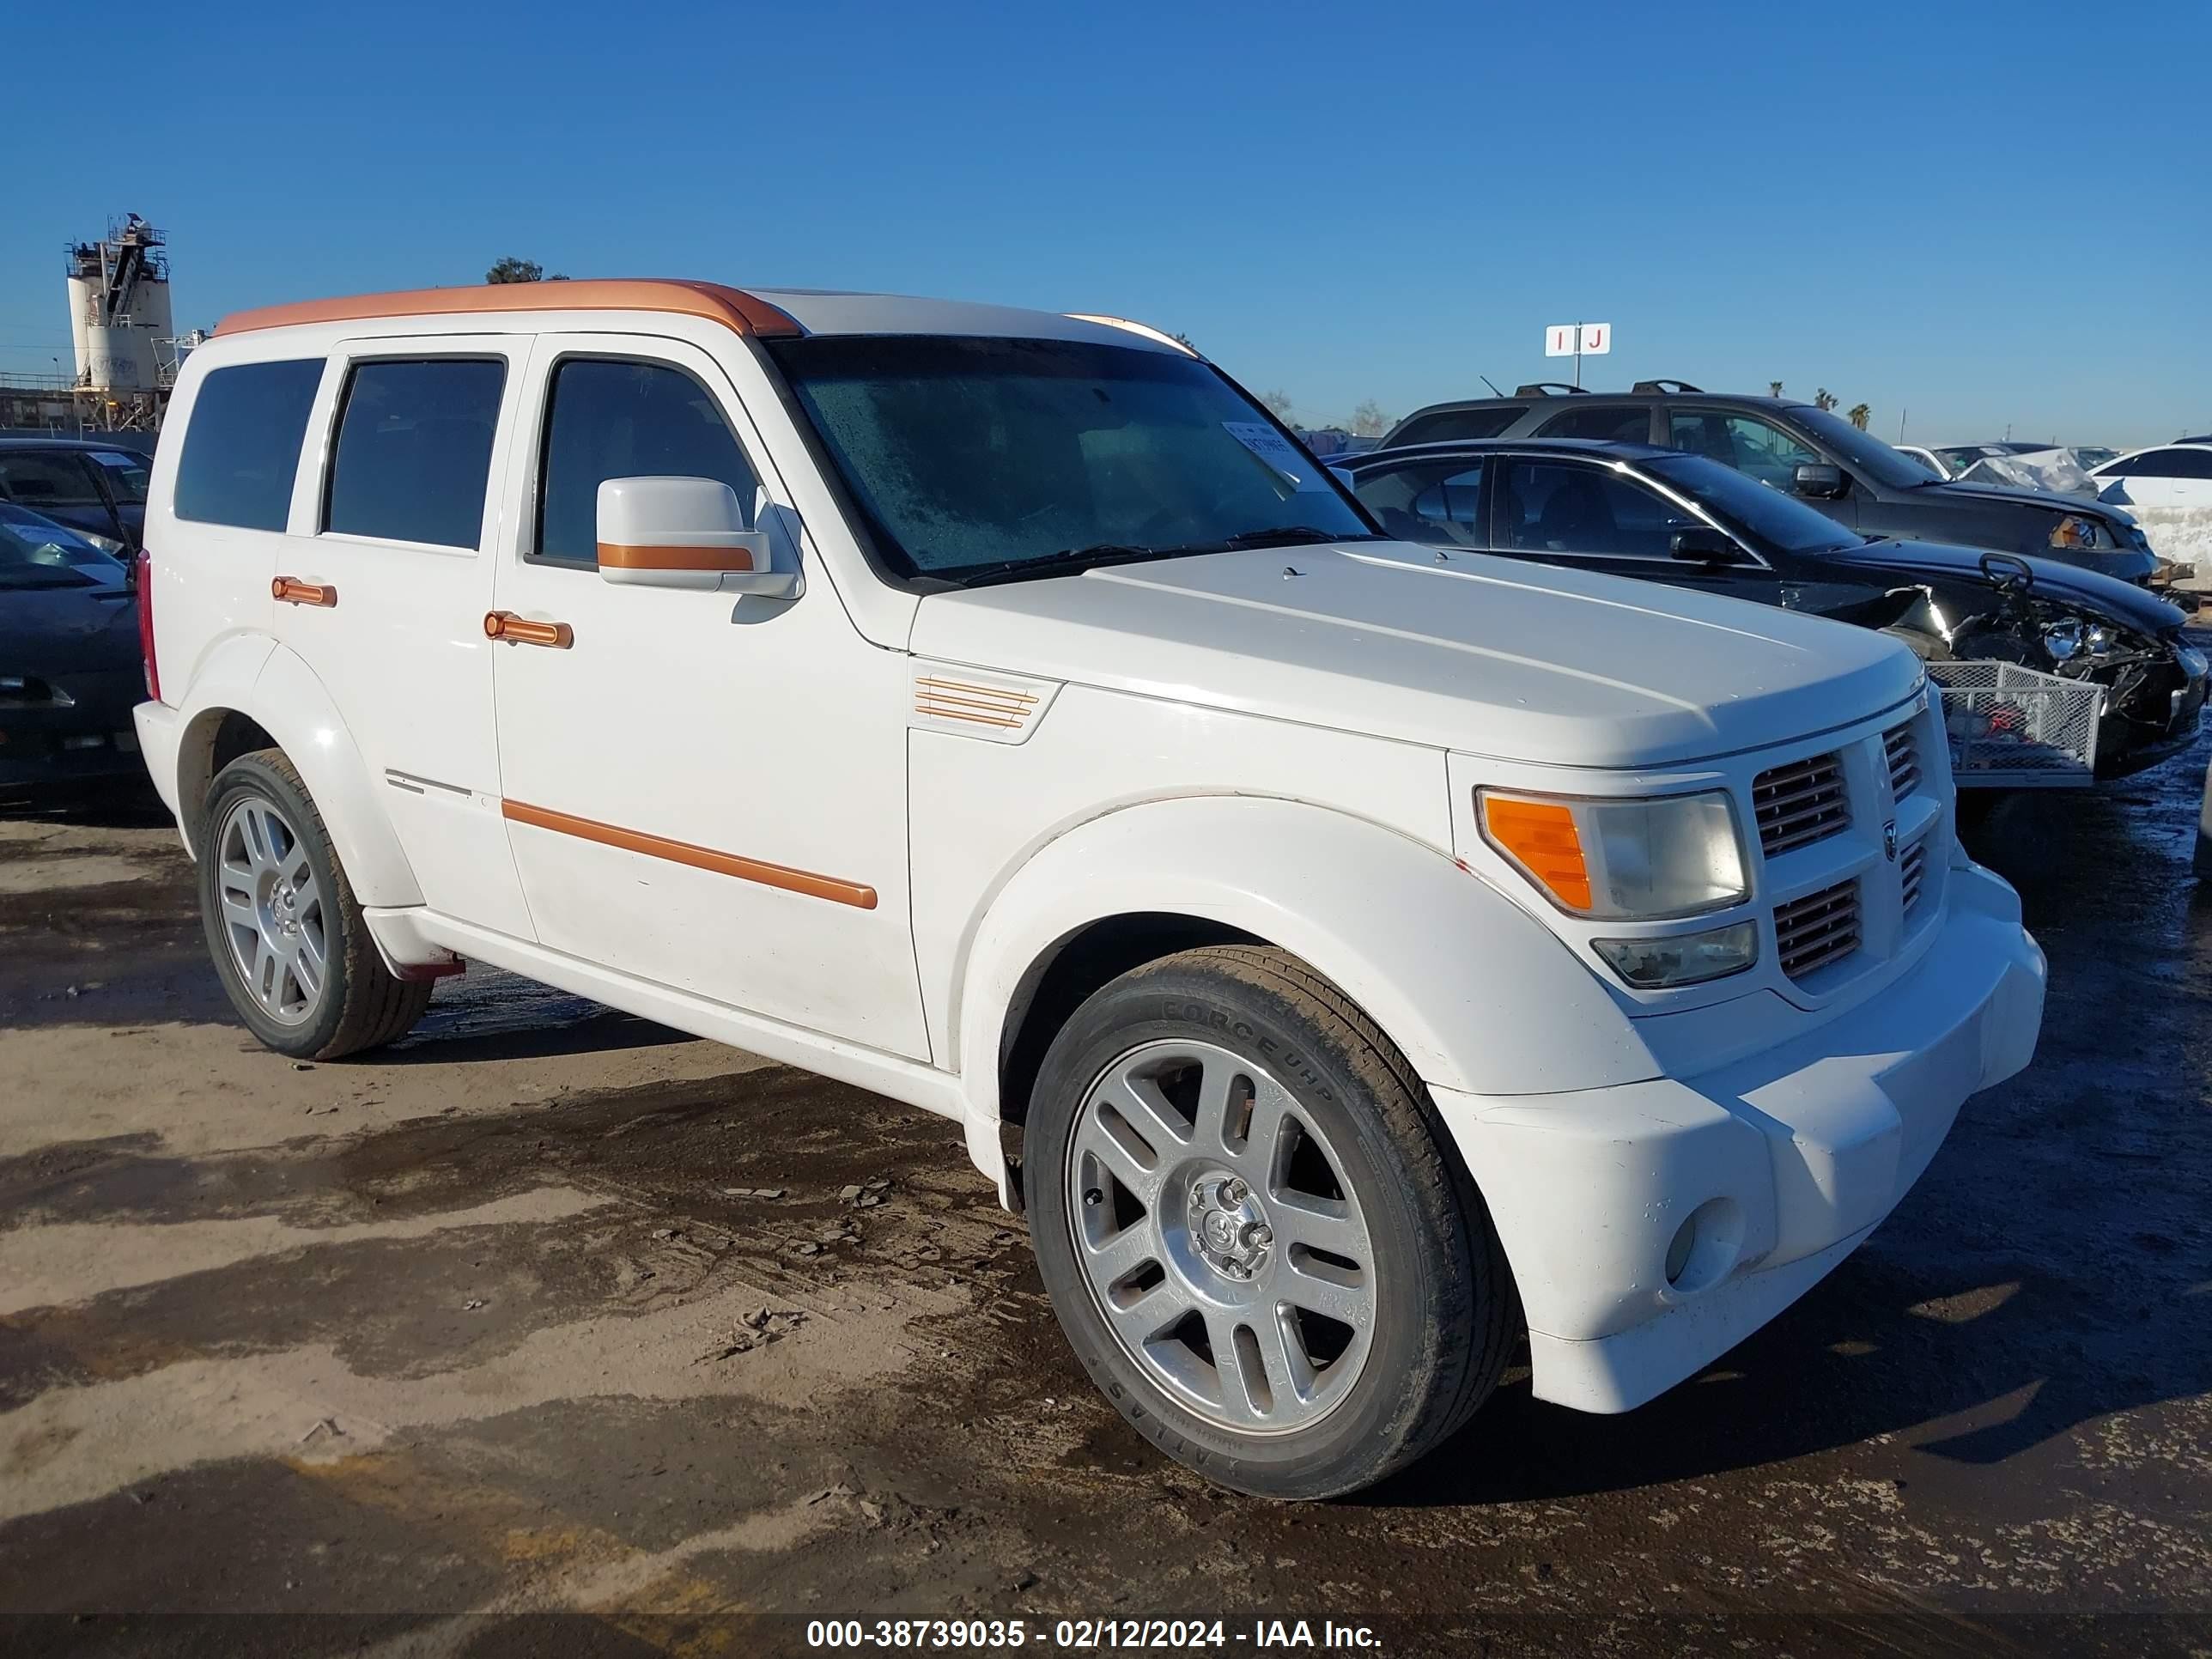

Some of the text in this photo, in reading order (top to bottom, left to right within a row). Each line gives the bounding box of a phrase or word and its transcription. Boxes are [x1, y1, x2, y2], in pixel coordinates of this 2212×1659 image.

[1589, 329, 1601, 348] J
[1163, 1000, 1279, 1061] FORCE
[1285, 1054, 1332, 1101] UHP
